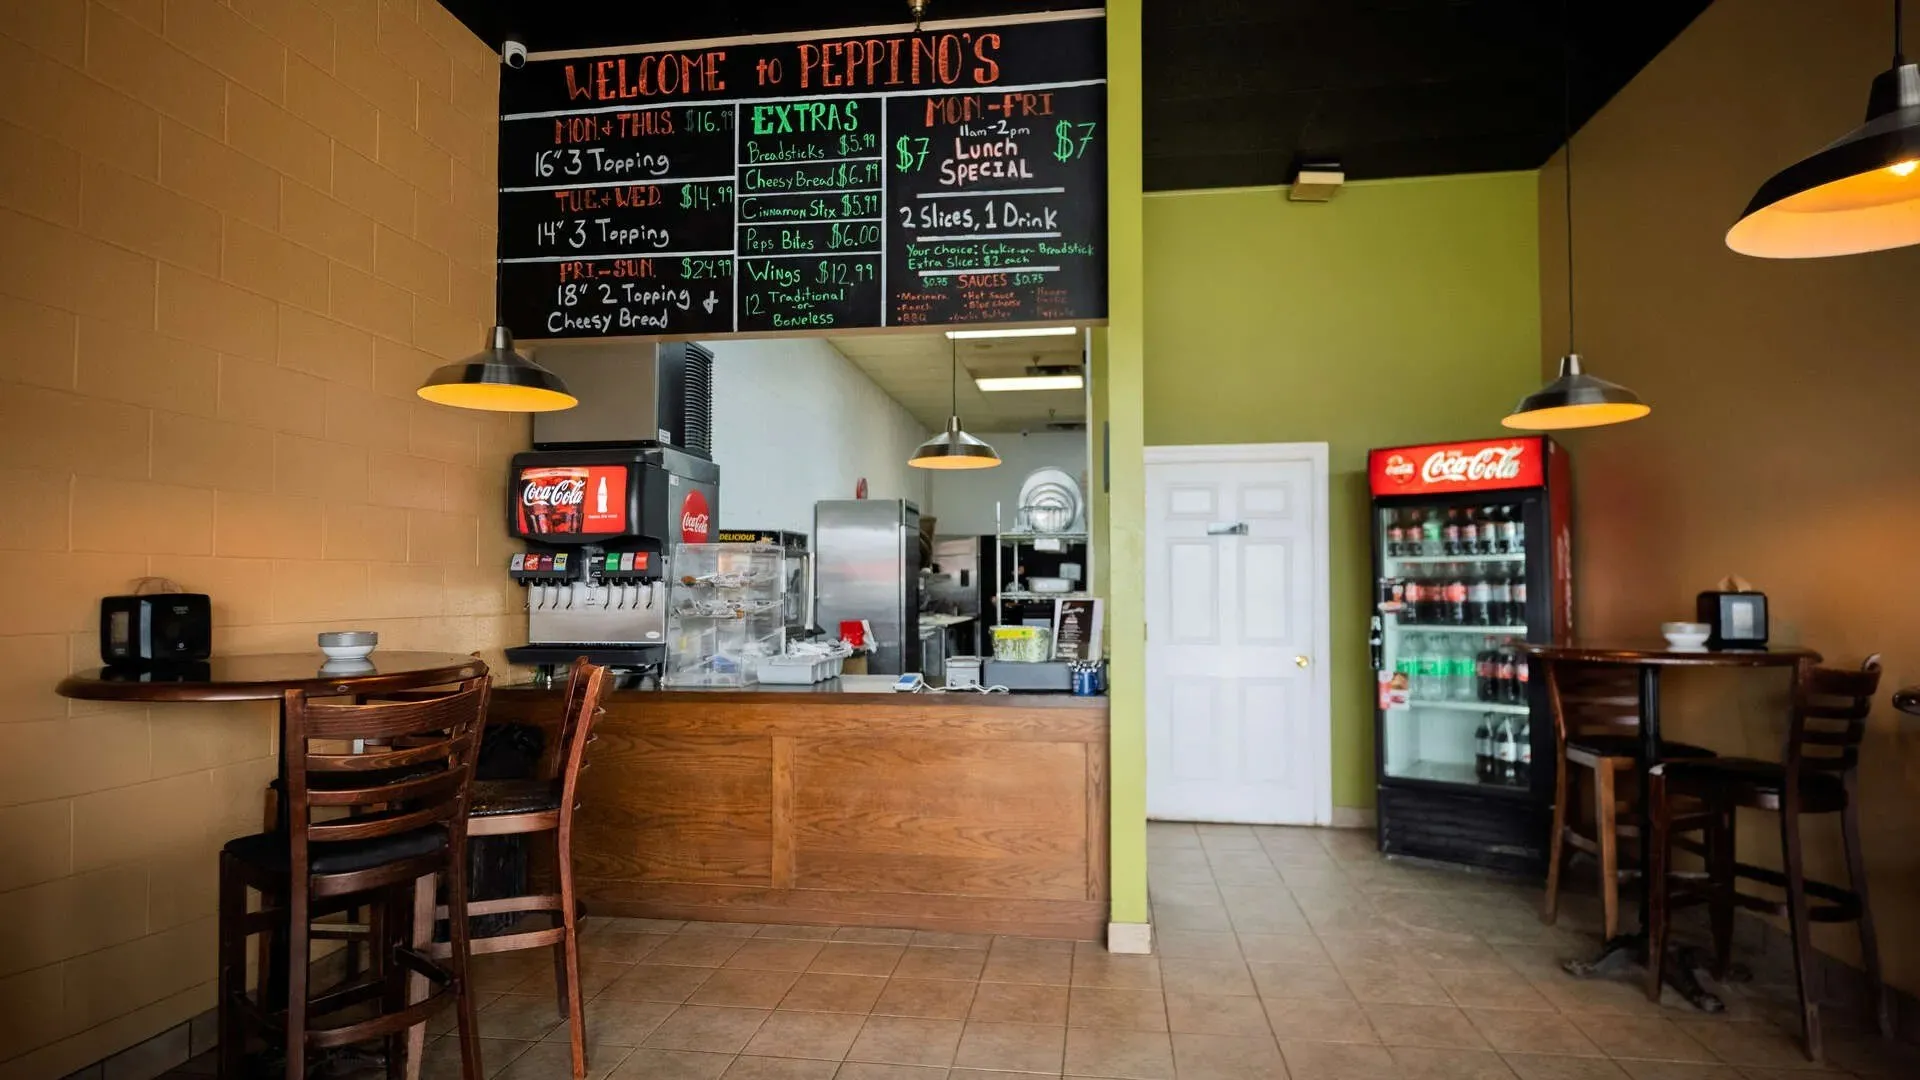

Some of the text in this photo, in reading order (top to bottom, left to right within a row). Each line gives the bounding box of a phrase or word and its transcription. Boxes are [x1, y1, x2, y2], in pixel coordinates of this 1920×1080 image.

[564, 33, 1001, 100] WELCOME to PEPPINO'S
[685, 110, 734, 134] $16.99
[751, 100, 858, 135] EXTRAS
[747, 133, 875, 164] Breadsticks $5.99
[896, 135, 930, 173] $7
[955, 137, 1018, 160] Lunch
[1053, 120, 1096, 163] $7
[564, 150, 582, 175] 3
[587, 148, 669, 175] Topping
[938, 159, 1034, 187] SPECIAL
[745, 163, 878, 190] Cheesy Bread $6.99
[680, 183, 733, 210] $14.99
[810, 200, 836, 218] Stix
[841, 194, 877, 217] $5.99
[900, 200, 1058, 231] 2 Slices, 1 Drink
[569, 219, 586, 248] 3
[595, 218, 669, 247] Topping
[747, 223, 880, 252] Peps Bites $6.00
[906, 244, 930, 257] Your
[934, 243, 979, 255] Choice:
[908, 256, 1030, 271] Extra Slice: $2 each
[680, 258, 732, 280] $24.99
[747, 260, 873, 287] Wings $12.99
[923, 273, 1044, 288] $0.75 SAUCES $0.75
[598, 284, 618, 304] 2
[621, 283, 690, 310] Topping
[745, 294, 766, 316] 12
[768, 286, 844, 303] Traditional
[547, 308, 668, 333] Cheesy Bread
[773, 311, 834, 327] Boneless
[1421, 446, 1525, 484] Coca-Cola
[523, 480, 586, 506] Coca-Cola
[682, 511, 709, 533] Coca-Cola
[720, 533, 755, 541] DELICIOUS
